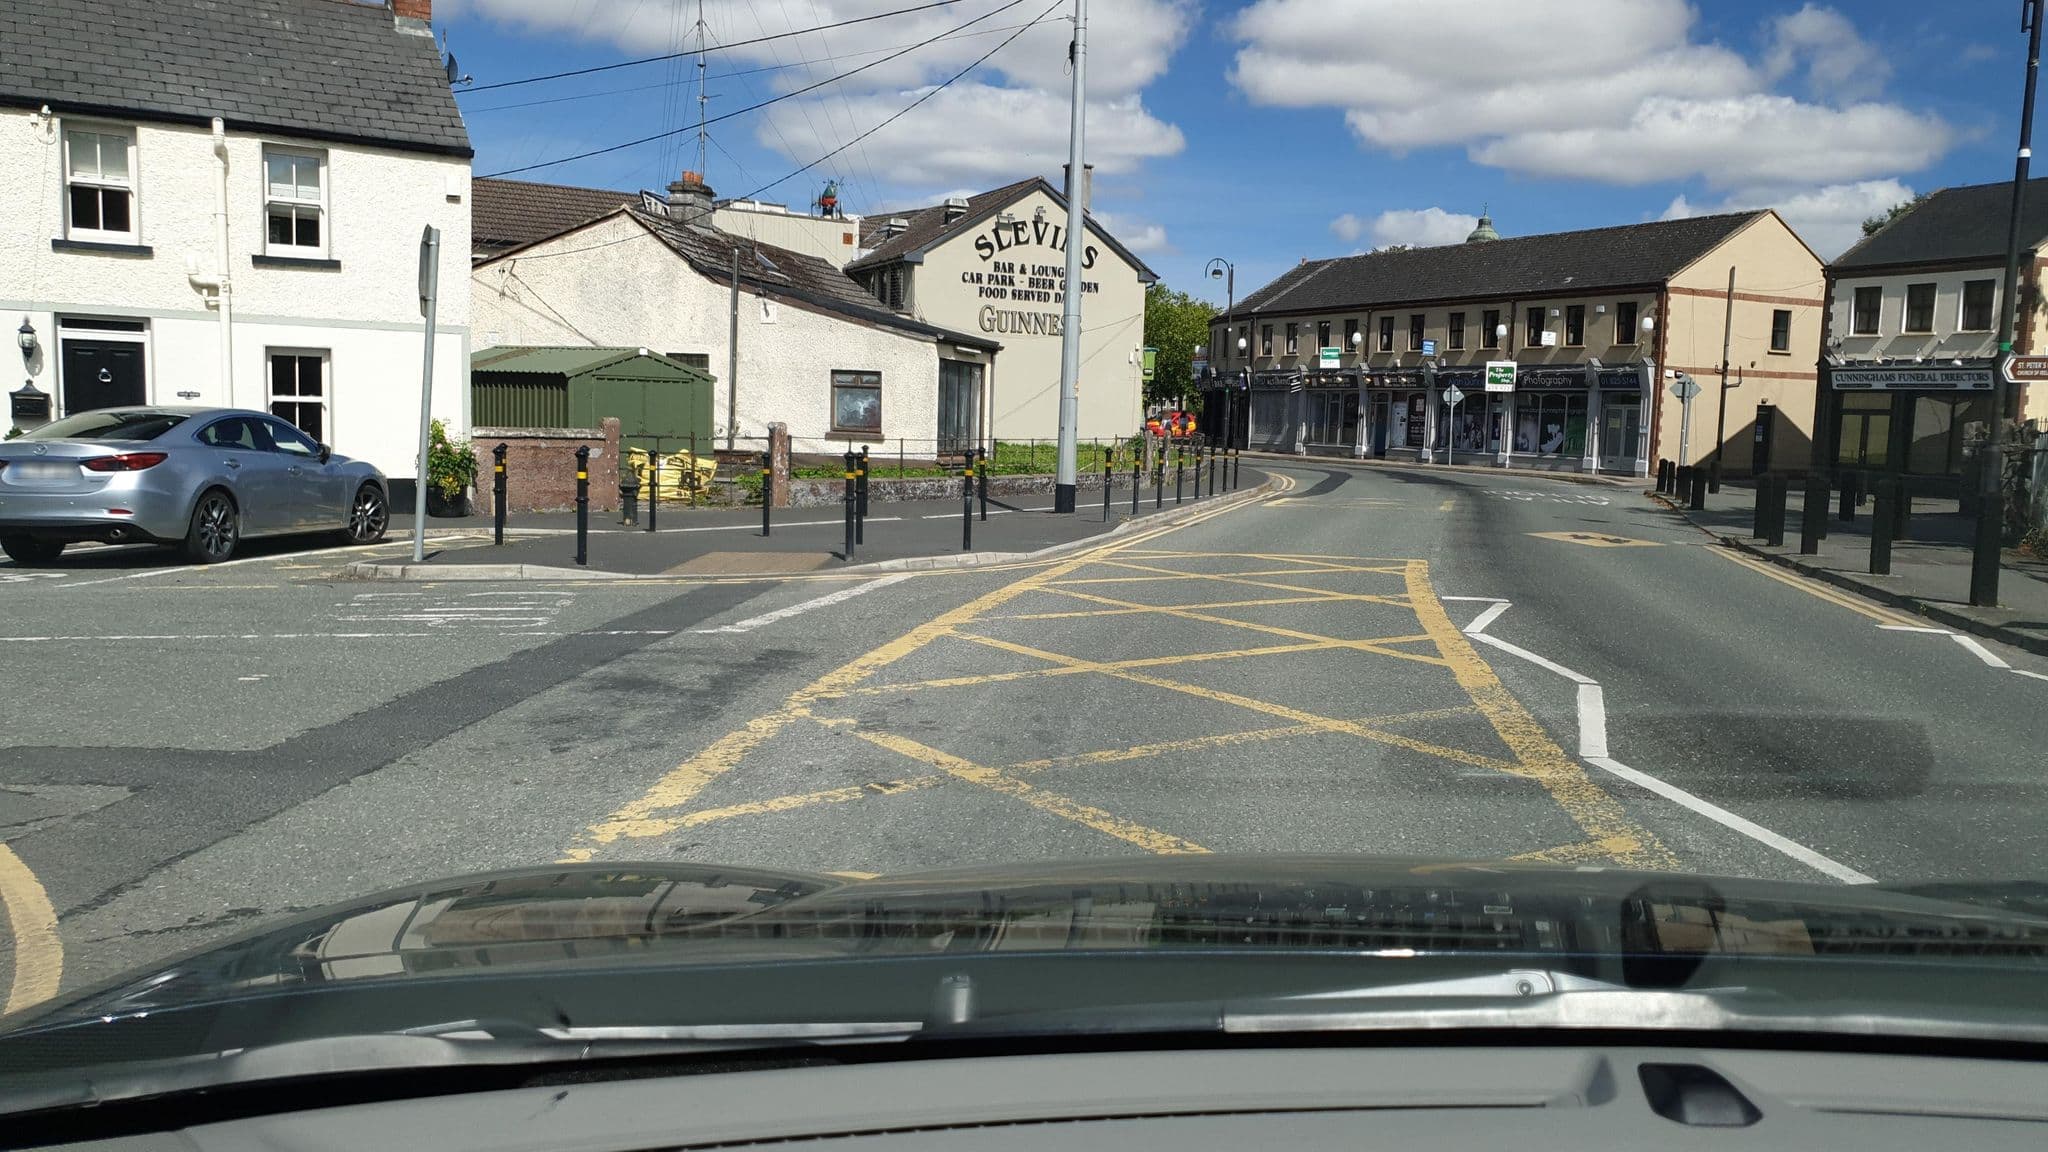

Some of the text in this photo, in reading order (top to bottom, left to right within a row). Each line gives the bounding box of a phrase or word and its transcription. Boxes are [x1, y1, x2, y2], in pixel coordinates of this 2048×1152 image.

[974, 220, 1099, 270] SLEVIS
[993, 261, 1065, 278] BAR & LOUNG
[962, 272, 983, 284] CAR
[988, 274, 1015, 287] PARK
[1028, 277, 1055, 290] BEER
[1059, 281, 1099, 294] GDEN
[979, 286, 1007, 299] FOOD
[1011, 289, 1050, 303] SERVED
[978, 304, 1082, 336] GUINNE
[1523, 375, 1573, 386] Photography
[1835, 372, 1990, 382] CUNNINGHAMS FUNERAL DIRECTORS
